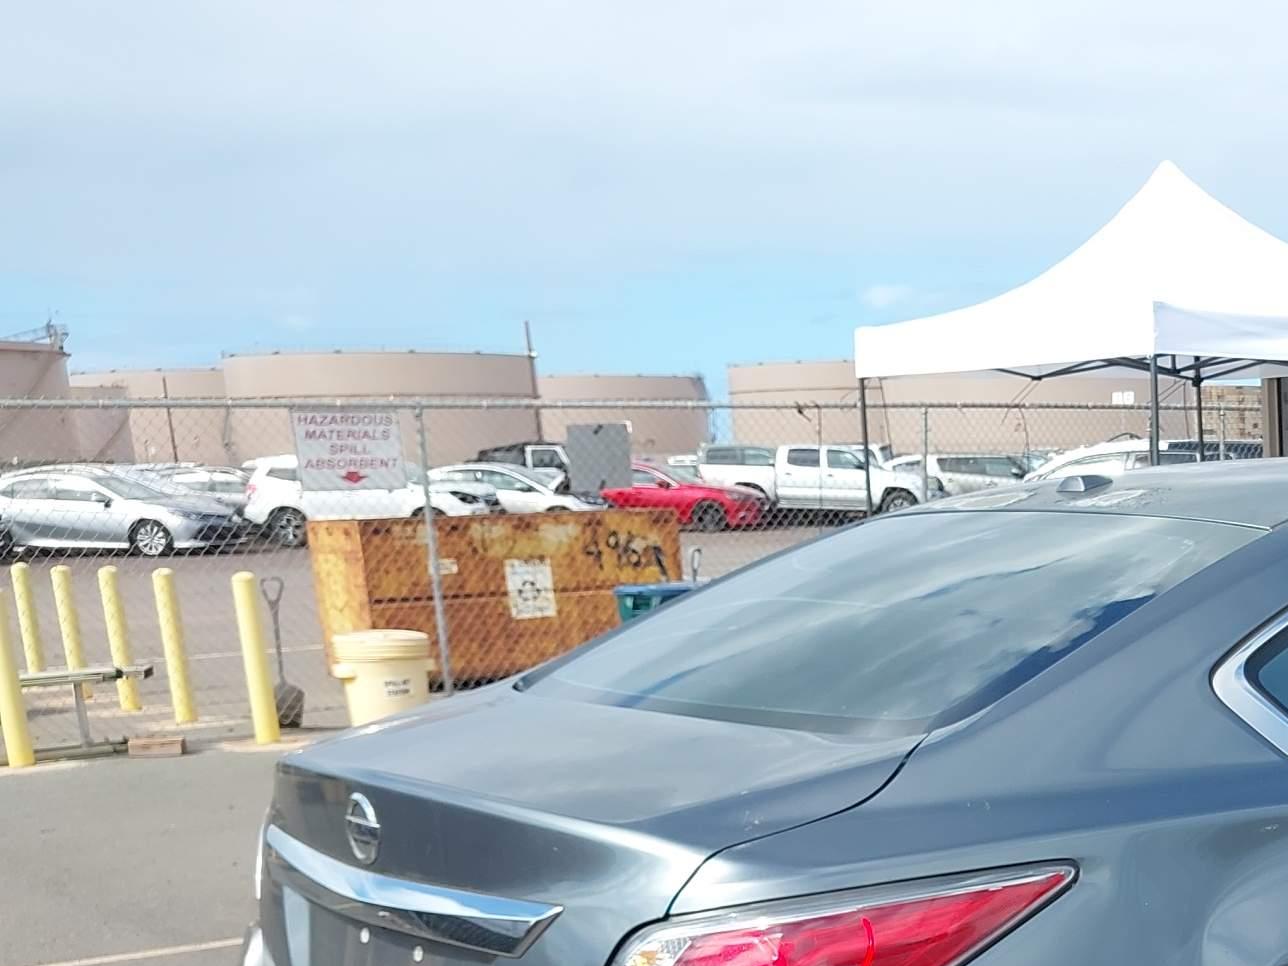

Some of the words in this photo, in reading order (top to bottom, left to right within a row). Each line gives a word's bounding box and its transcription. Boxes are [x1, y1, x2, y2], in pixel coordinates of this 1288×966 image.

[297, 415, 393, 427] HAZARDOUS
[304, 428, 391, 440] MATERIALS
[328, 442, 369, 456] SPILL
[304, 458, 398, 470] ABSORBENT
